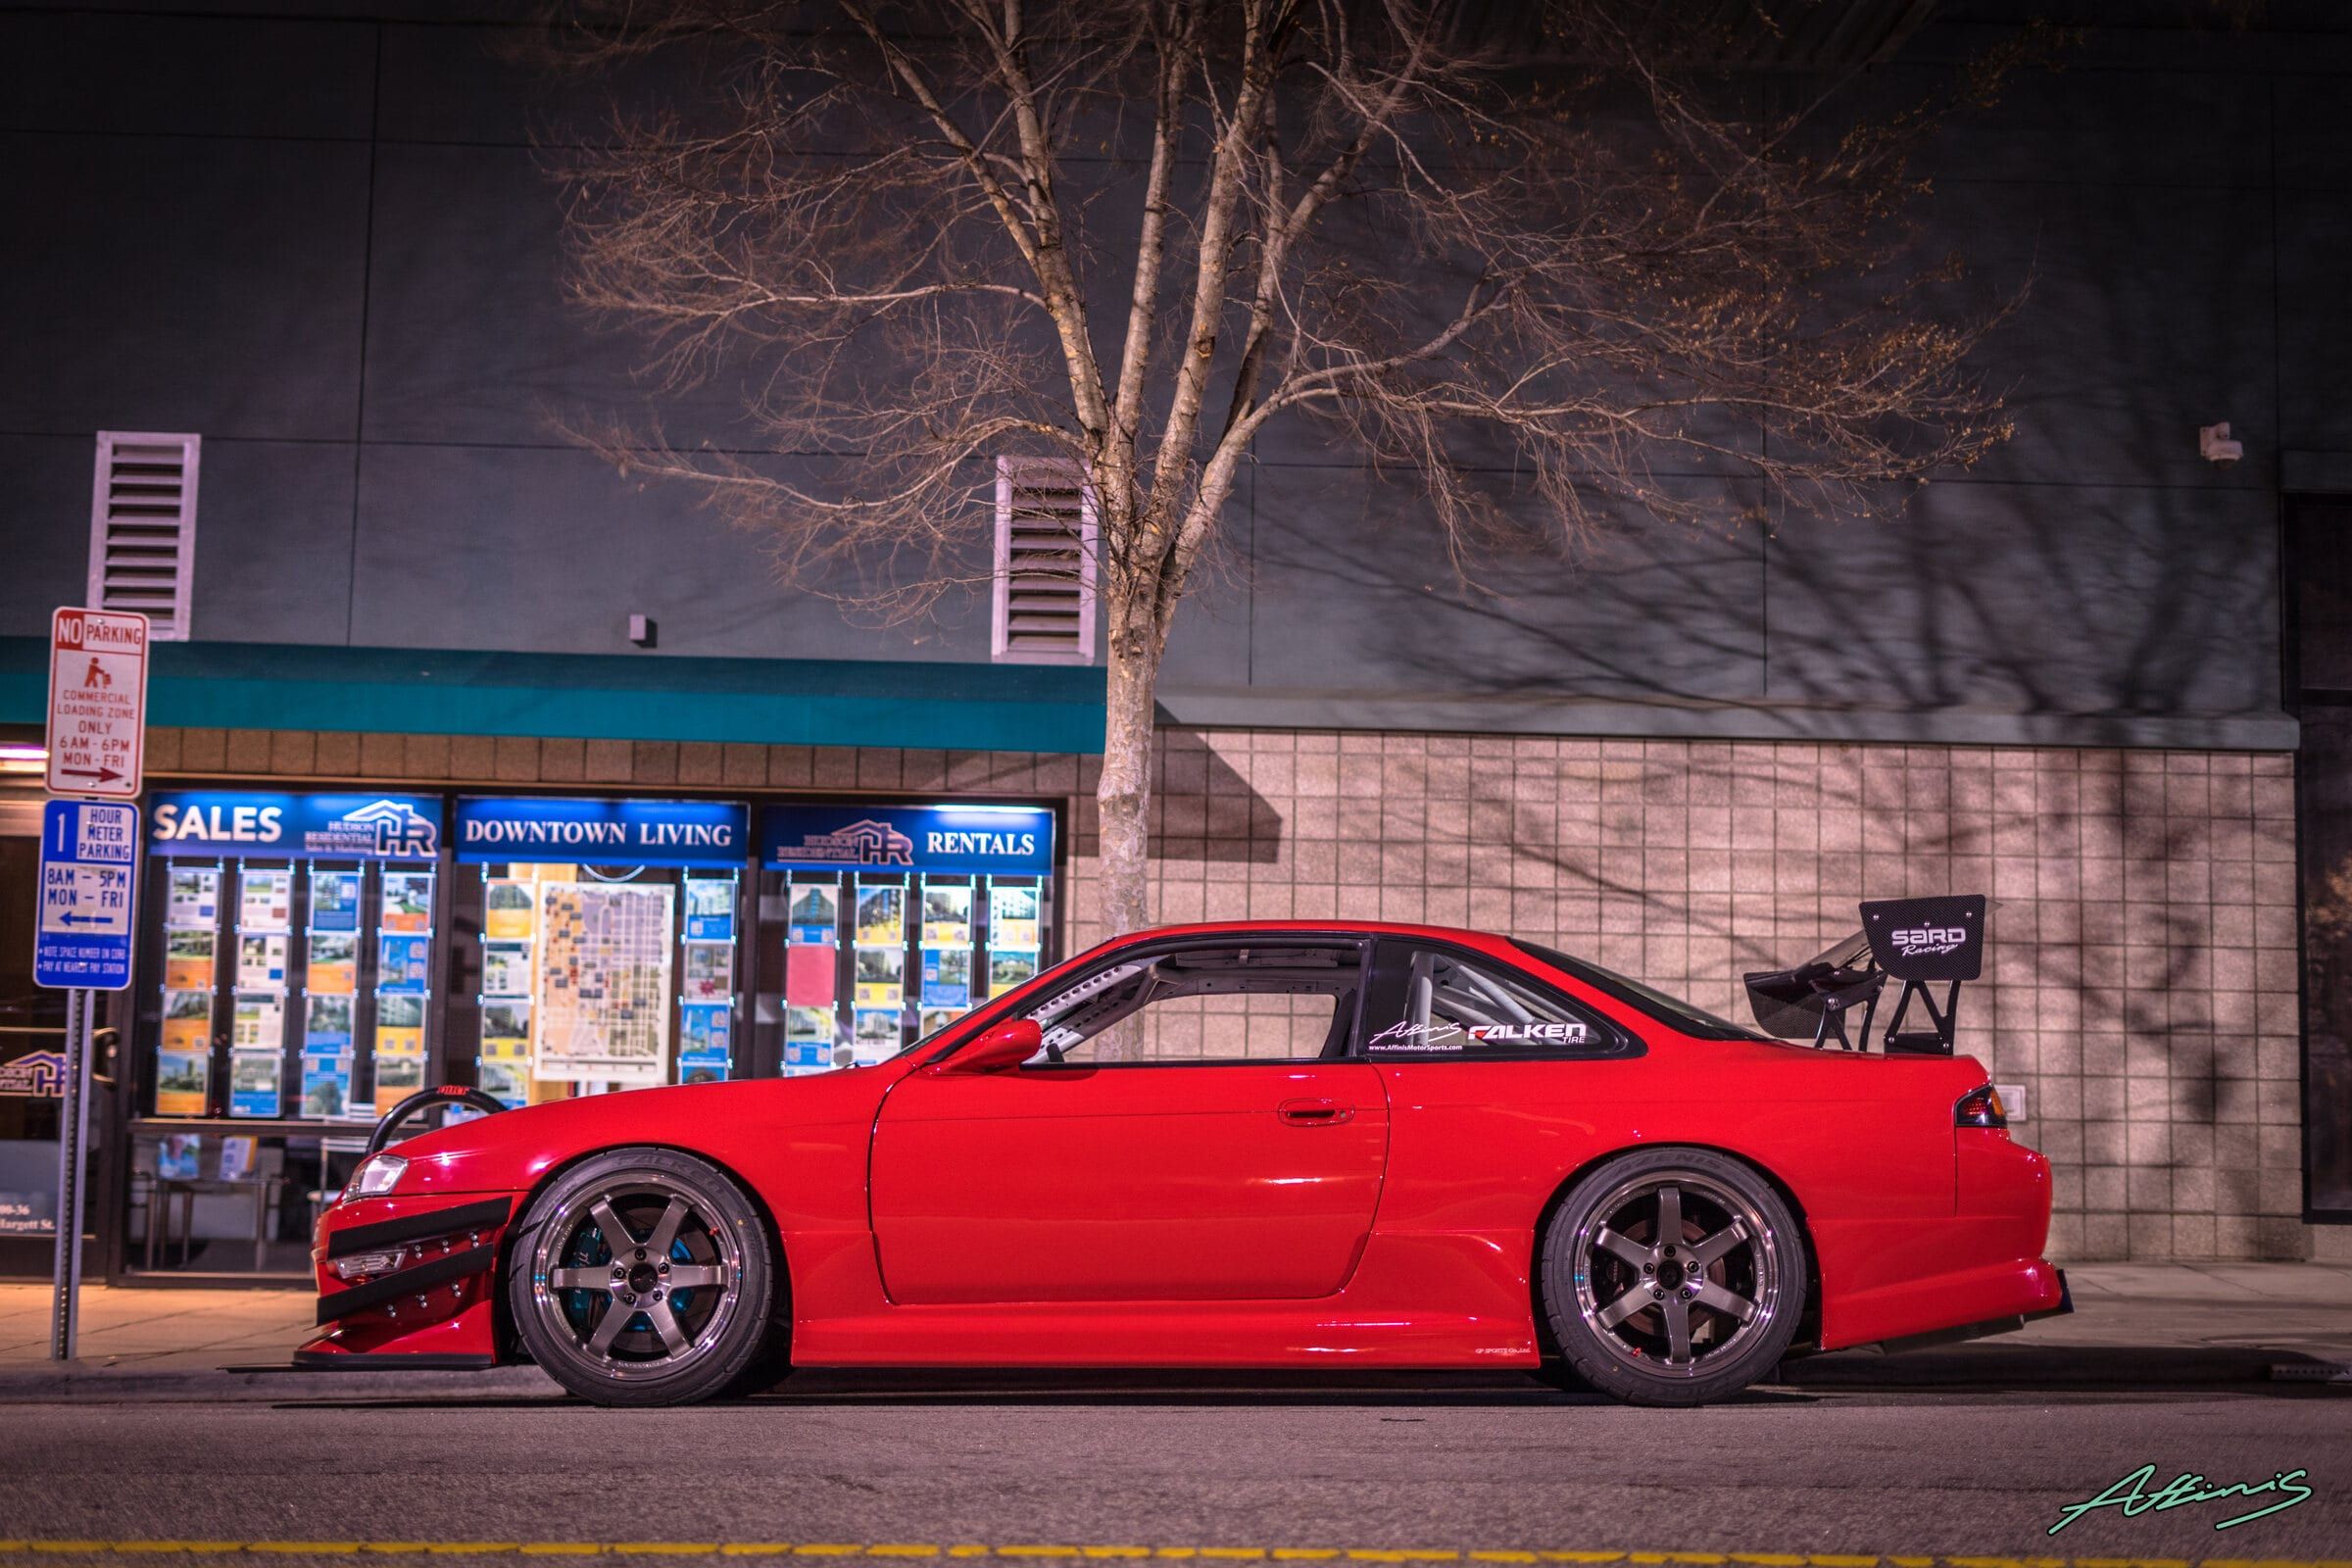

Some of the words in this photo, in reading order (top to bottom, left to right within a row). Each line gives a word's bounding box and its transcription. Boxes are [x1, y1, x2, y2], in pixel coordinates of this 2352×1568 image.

[59, 617, 82, 644] NO
[85, 624, 141, 645] PARKING
[64, 690, 130, 705] COMMERCIAL
[57, 704, 103, 717] LOADING
[108, 708, 134, 719] ZONE
[78, 720, 112, 734] ONLY
[102, 739, 129, 753] 6PM
[64, 753, 91, 765] MON
[104, 755, 124, 768] FRI
[90, 808, 122, 823] HOUR
[152, 804, 282, 843] SALES
[58, 813, 65, 853] 1
[87, 824, 123, 841] METER
[465, 819, 627, 845] DOWNTOWN
[639, 822, 732, 847] LIVING
[78, 843, 129, 859] PARKING
[927, 831, 1036, 856] RENTALS
[47, 868, 74, 886] 8AM
[99, 870, 126, 888] 5PM
[48, 889, 77, 906] MON
[101, 891, 123, 907] FRI
[1902, 943, 1958, 956] Racing
[1468, 1023, 1587, 1040] FALKEN
[40, 1218, 56, 1230] St.
